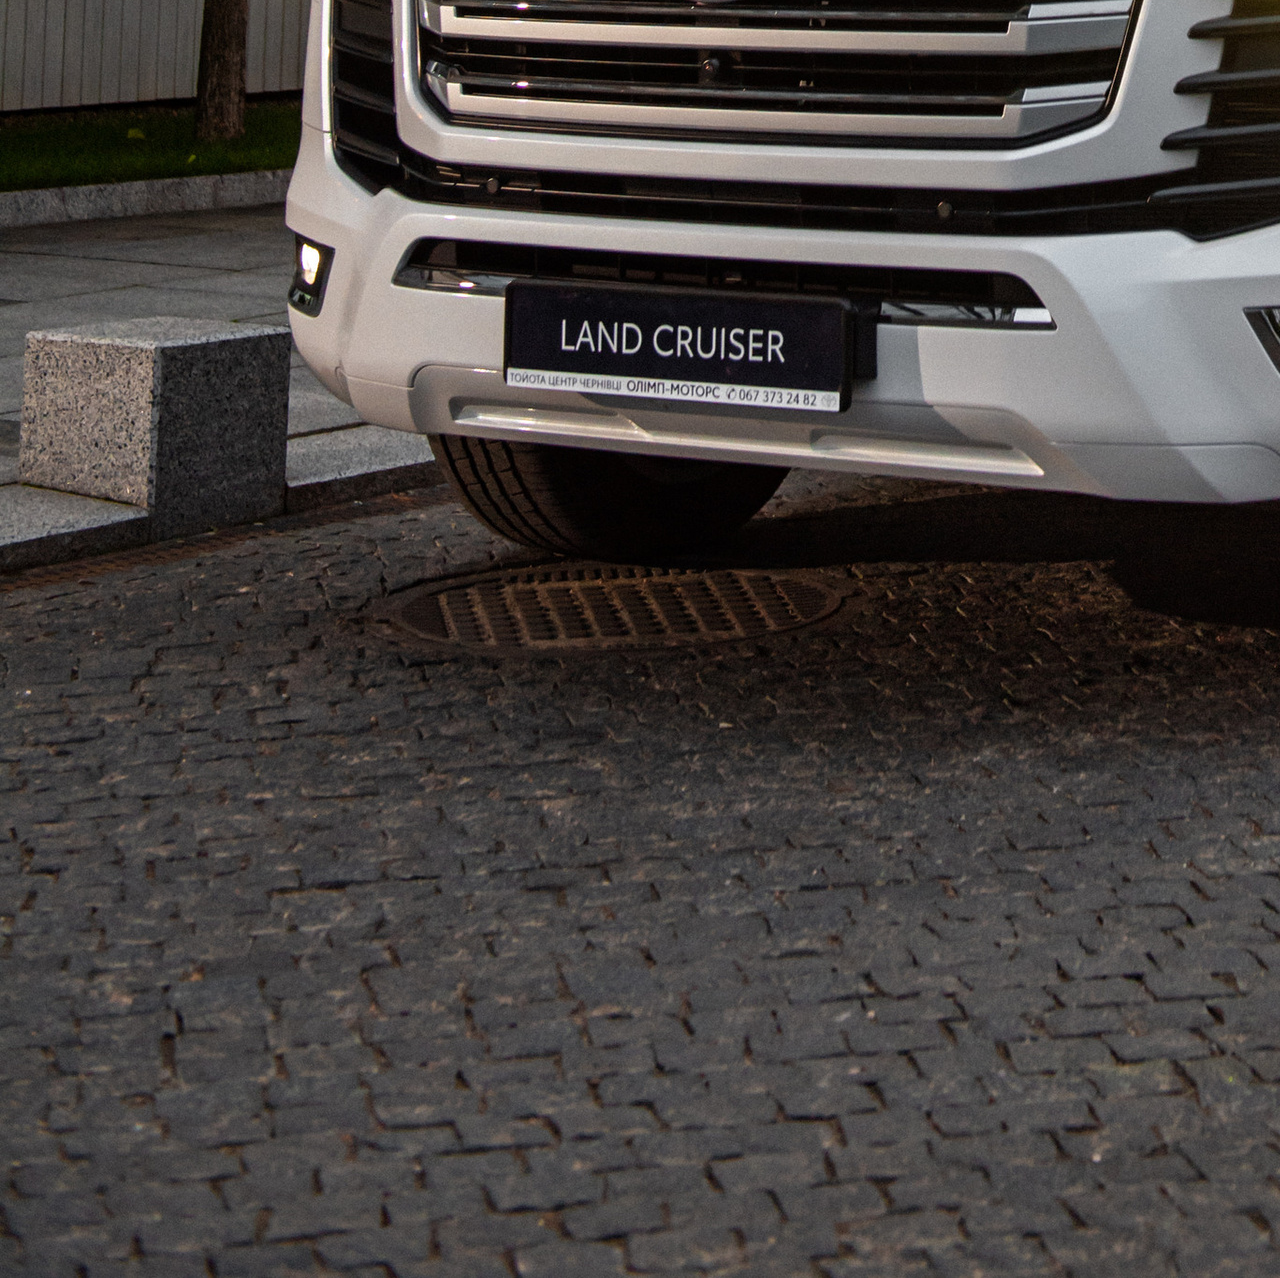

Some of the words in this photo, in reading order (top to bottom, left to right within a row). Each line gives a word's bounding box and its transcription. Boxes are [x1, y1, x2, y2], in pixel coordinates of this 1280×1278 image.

[561, 319, 643, 355] LAND
[653, 324, 785, 363] CRUISER
[510, 371, 546, 385] ТОЙОТА
[546, 375, 578, 388] ЦЕНТР
[580, 378, 622, 391] ЧЕРНІВЦІ
[626, 379, 720, 399] ОЛІМП-МОТОРС
[738, 389, 760, 402] 067
[763, 391, 783, 404] 373
[786, 392, 800, 405] 24
[803, 394, 817, 407] 82
